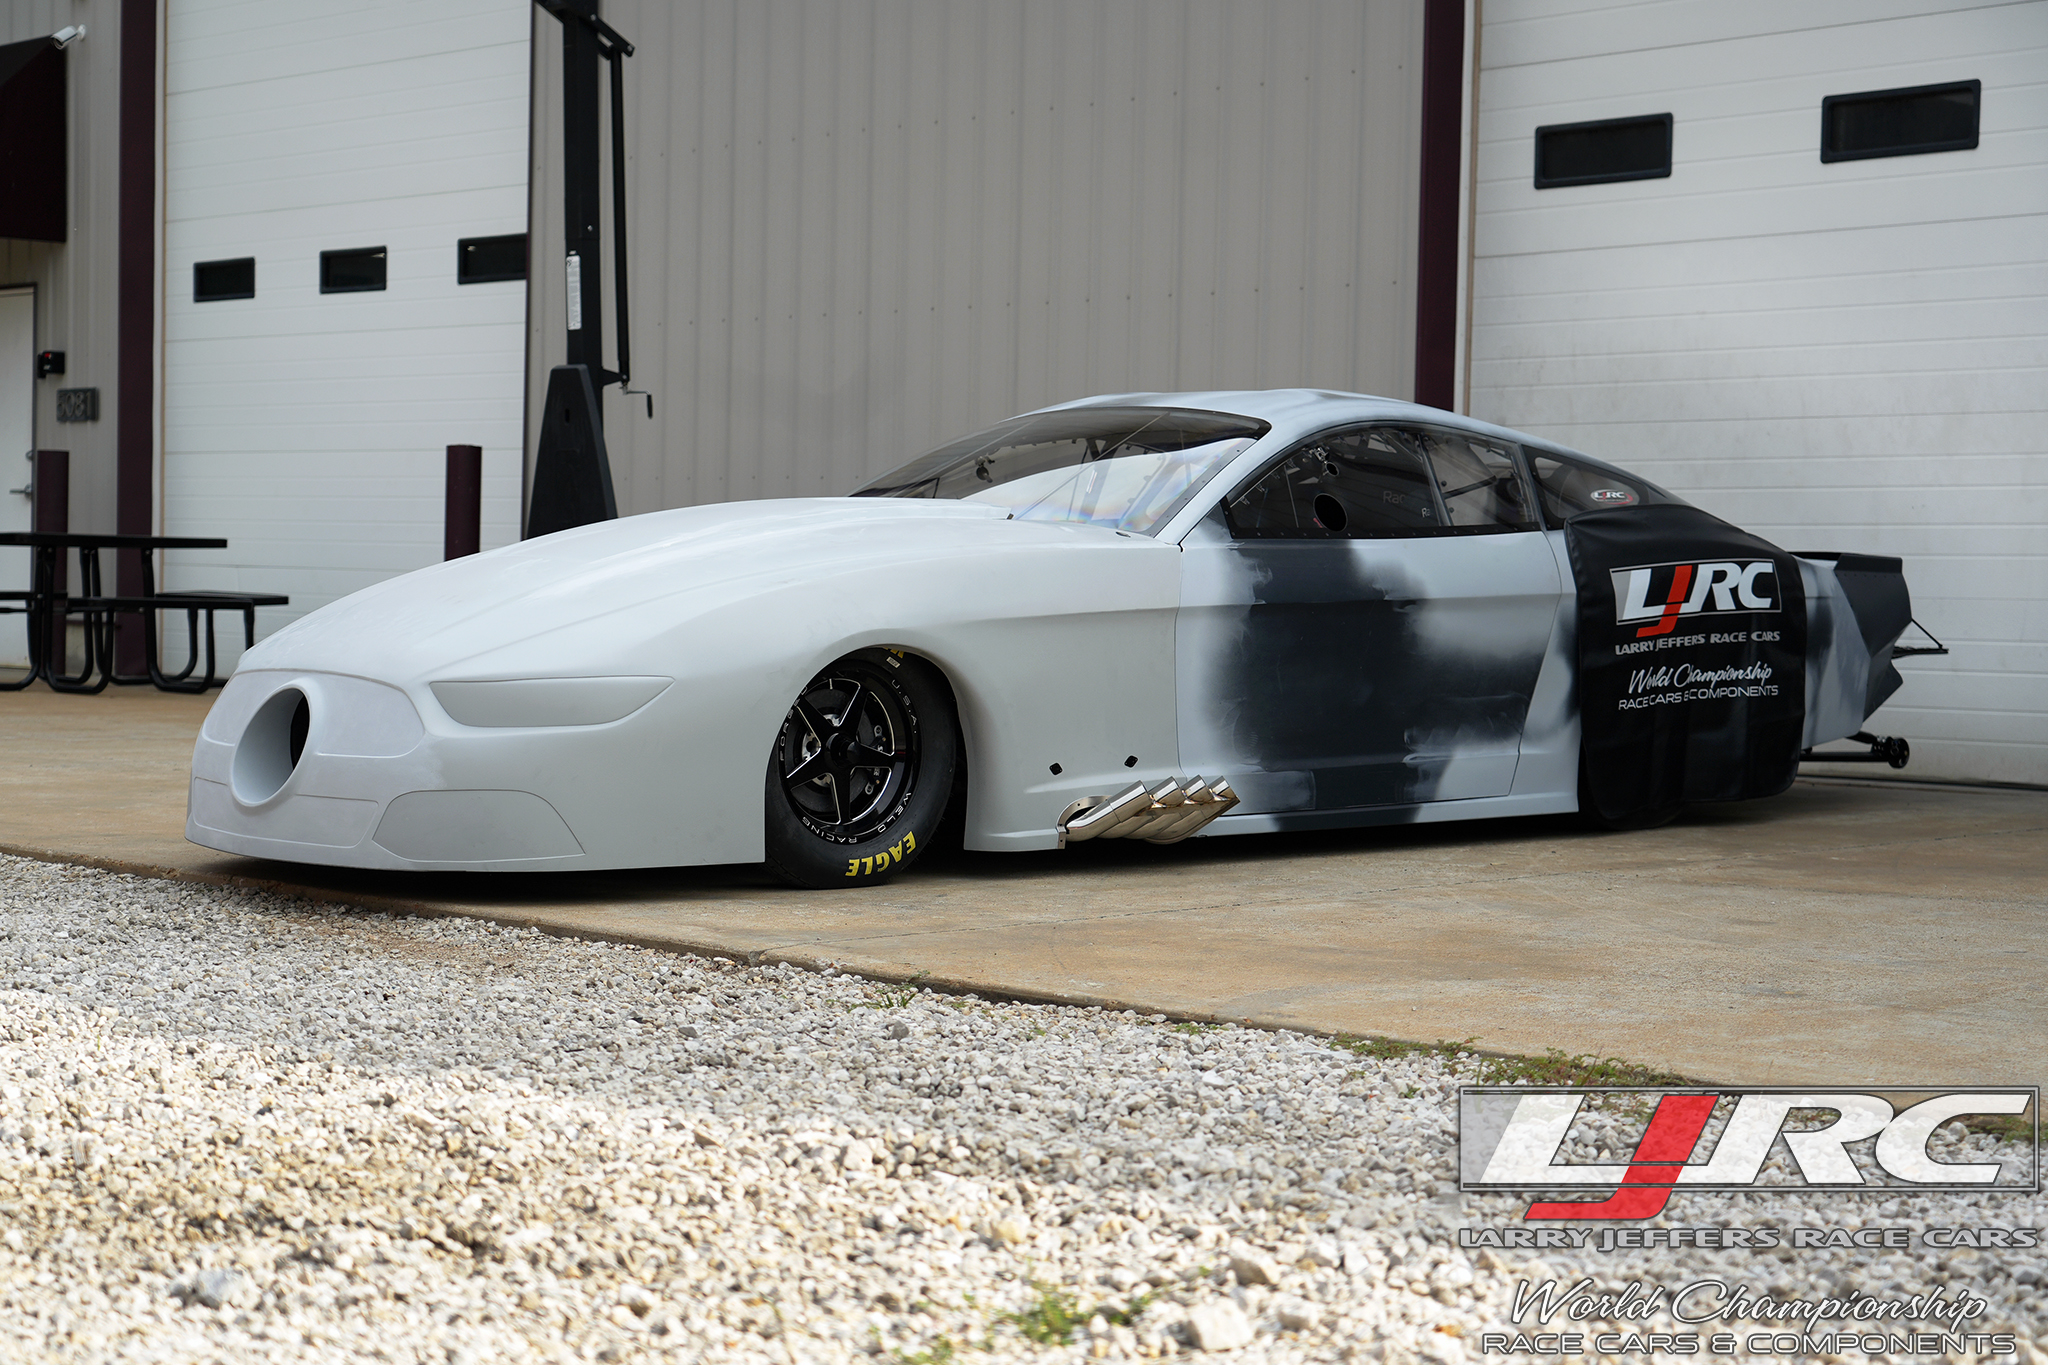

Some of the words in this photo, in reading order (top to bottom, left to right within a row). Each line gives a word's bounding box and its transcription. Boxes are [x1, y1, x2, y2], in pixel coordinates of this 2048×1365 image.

[1622, 562, 1774, 638] LJRC
[1615, 640, 1655, 656] LARRY
[1655, 633, 1706, 652] JEFFERS
[1709, 631, 1747, 644] RACE
[1750, 630, 1780, 642] CARS
[1628, 666, 1674, 694] World
[1618, 696, 1650, 711] RACE
[1649, 691, 1682, 706] CARS
[1689, 684, 1779, 700] COMPONENTS
[877, 792, 912, 833] WELD
[801, 816, 858, 844] RACING
[845, 831, 917, 877] EAGLE
